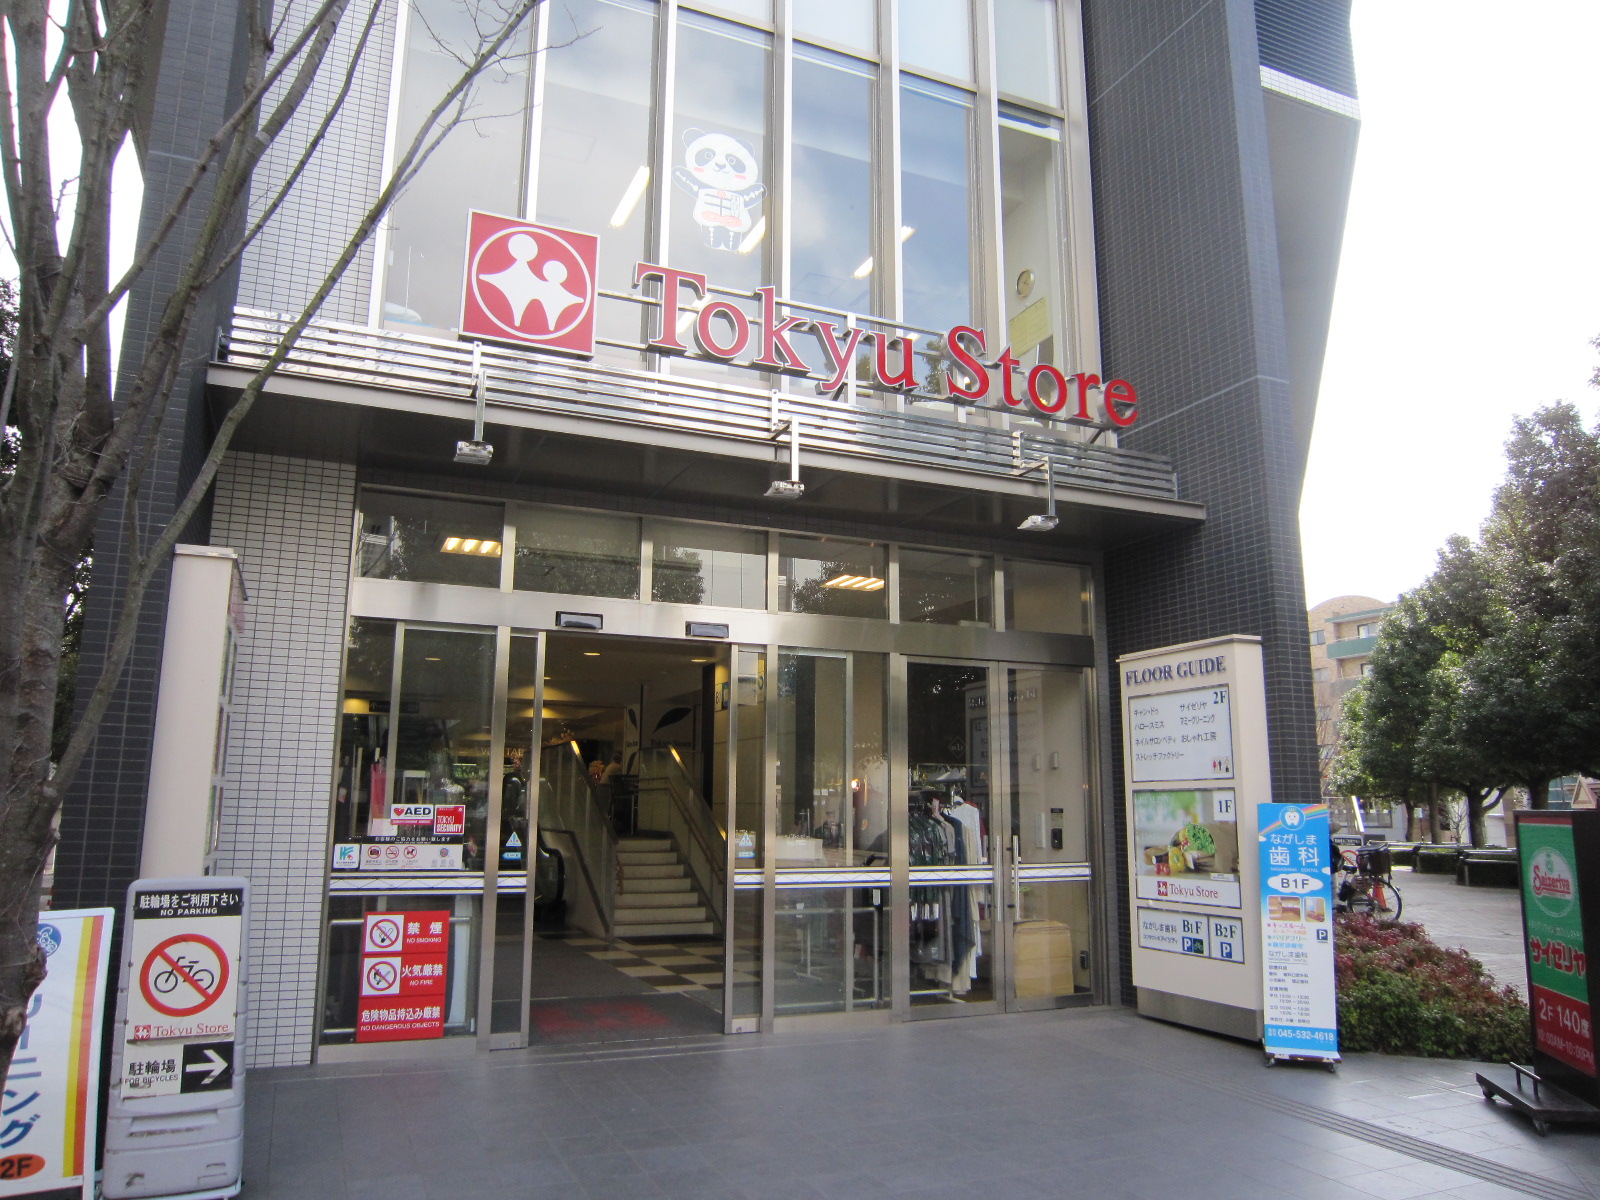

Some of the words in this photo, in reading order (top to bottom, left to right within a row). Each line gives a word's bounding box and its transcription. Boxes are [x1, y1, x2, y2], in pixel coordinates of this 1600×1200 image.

[634, 262, 920, 391] Tokyu
[945, 325, 1139, 428] Store
[1125, 665, 1174, 685] FLOOR
[1177, 656, 1227, 678] GUIDE
[1213, 691, 1227, 704] 2F
[1180, 702, 1208, 712] サイゼリヤ
[404, 807, 432, 816] AED
[1218, 800, 1232, 813] 1F
[436, 824, 462, 833] SECURITY
[1270, 834, 1317, 845] ながしま
[1269, 846, 1320, 866] 歯科
[1281, 878, 1310, 888] B1F
[1533, 865, 1571, 895] Saizeriya
[1170, 884, 1194, 897] Tokyu
[1196, 886, 1219, 899] Store
[139, 892, 239, 909] 駐輪場をご利用下さい
[177, 907, 218, 915] PARKING
[407, 922, 443, 934] 禁煙
[1143, 921, 1177, 933] ながしま歯科
[1182, 919, 1203, 934] B1F
[1214, 923, 1238, 938] B2F
[1530, 936, 1587, 979] サイゼリヤ
[401, 964, 443, 977] 火気厳禁
[361, 1006, 441, 1022] 危険物品持込み厳禁
[1540, 998, 1553, 1021] 2F
[153, 1024, 193, 1037] Tokyu
[196, 1022, 230, 1034] Store
[371, 1023, 411, 1031] DANGEROUS
[411, 1021, 440, 1029] OBJECTS
[1277, 1028, 1334, 1041] 045-532-4618
[128, 1058, 177, 1076] 駐輪場
[124, 1077, 140, 1085] FOR
[142, 1074, 179, 1084] BICYCLES
[0, 1155, 34, 1179] 2F
